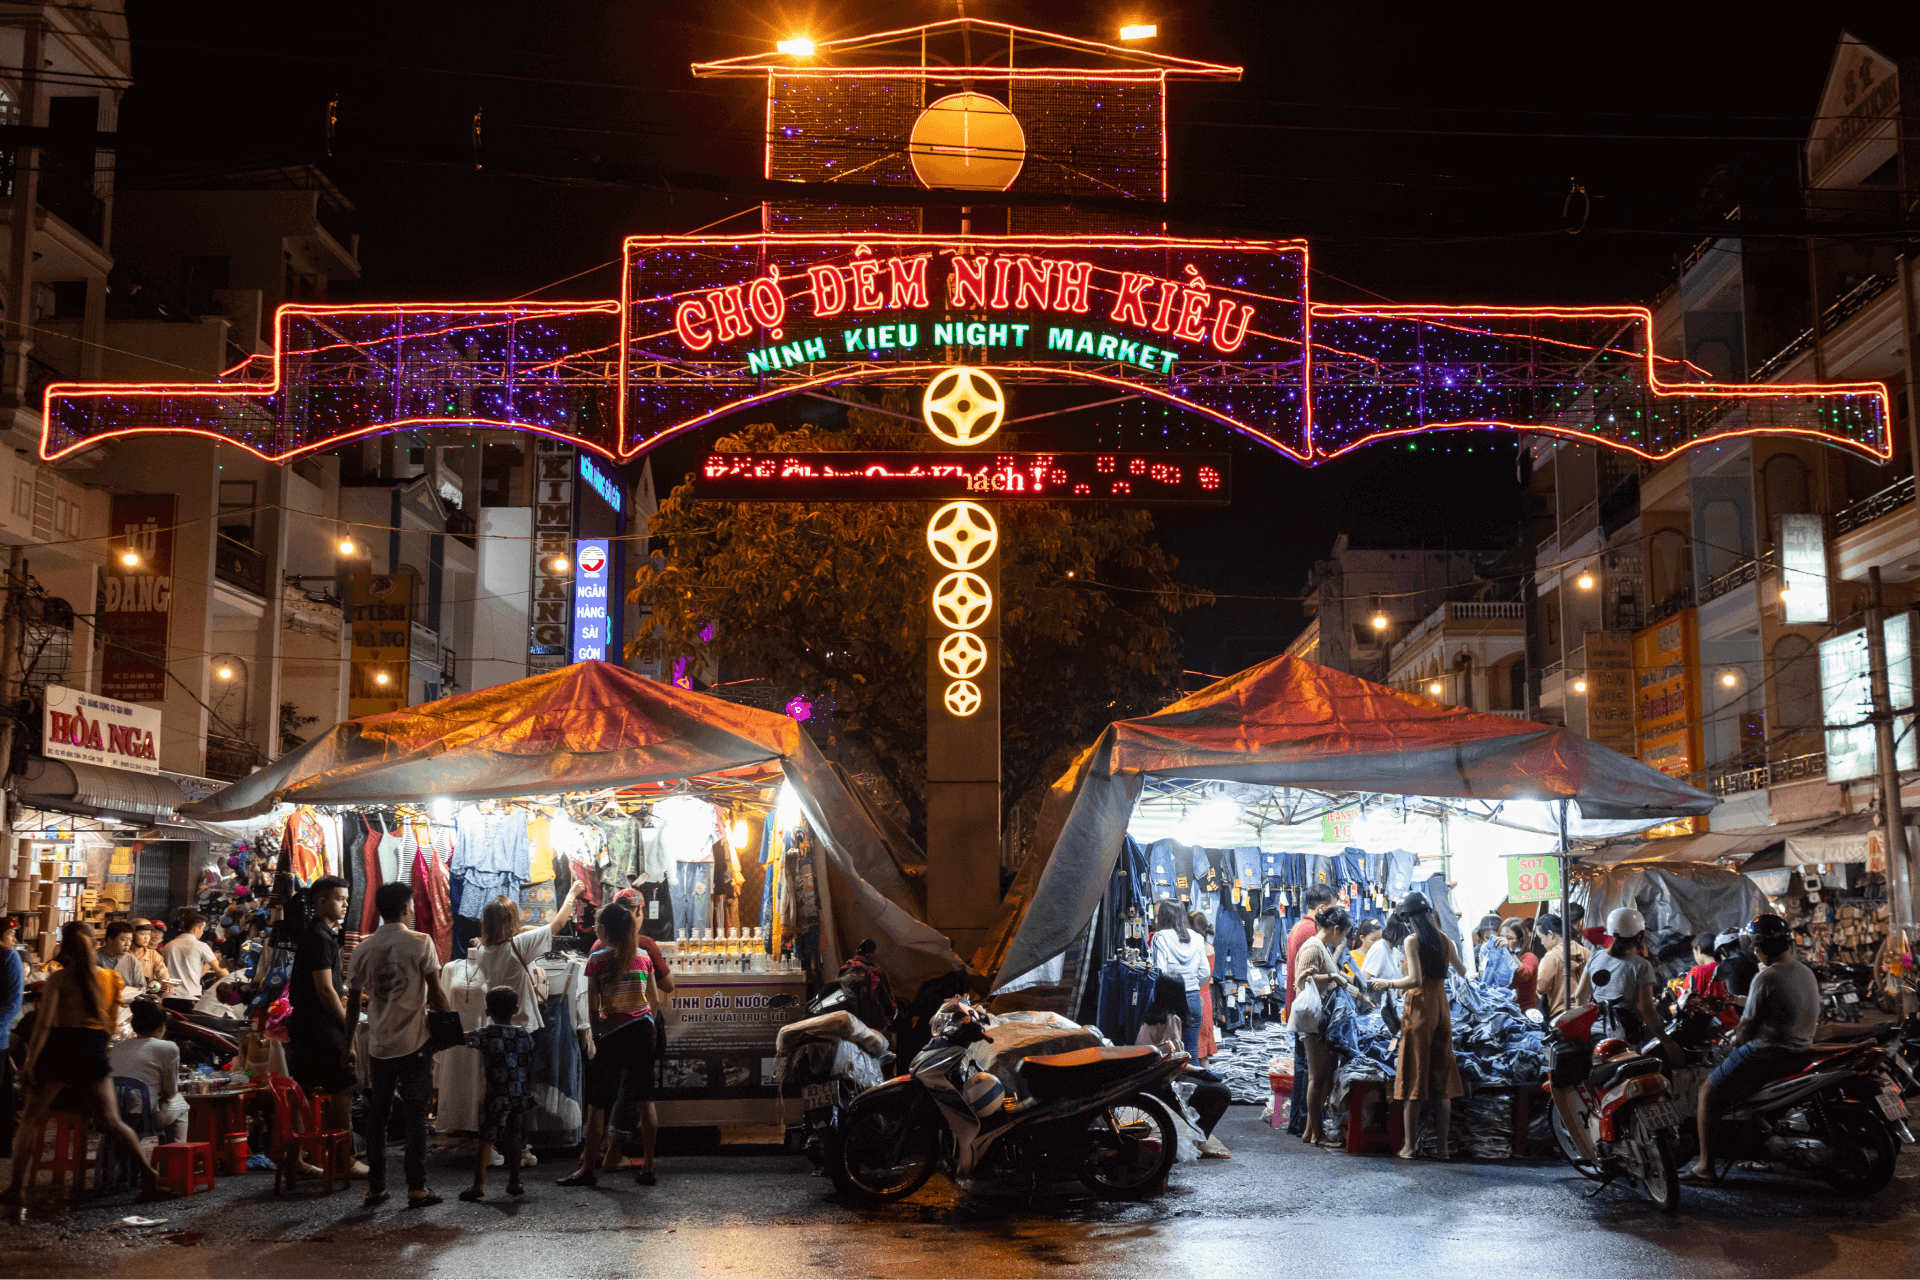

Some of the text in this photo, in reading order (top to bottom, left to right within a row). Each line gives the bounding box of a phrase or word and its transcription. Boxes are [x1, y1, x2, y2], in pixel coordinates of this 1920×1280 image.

[676, 243, 1255, 352] CHỢ ĐÊM NINH KIỀU
[747, 322, 1179, 375] NINH KIEU NIGHT MARKET
[539, 457, 571, 525] KIM
[577, 583, 606, 598] NGÂN
[576, 602, 605, 618] HÀNG
[581, 624, 599, 639] SÀI
[578, 646, 601, 660] GÒN
[49, 705, 157, 761] HÒA NGA
[1326, 810, 1352, 822] JEANS
[1518, 872, 1549, 892] 80
[670, 996, 701, 1010] TINH
[704, 991, 732, 1010] DẦU
[735, 993, 770, 1009] NƯỚC
